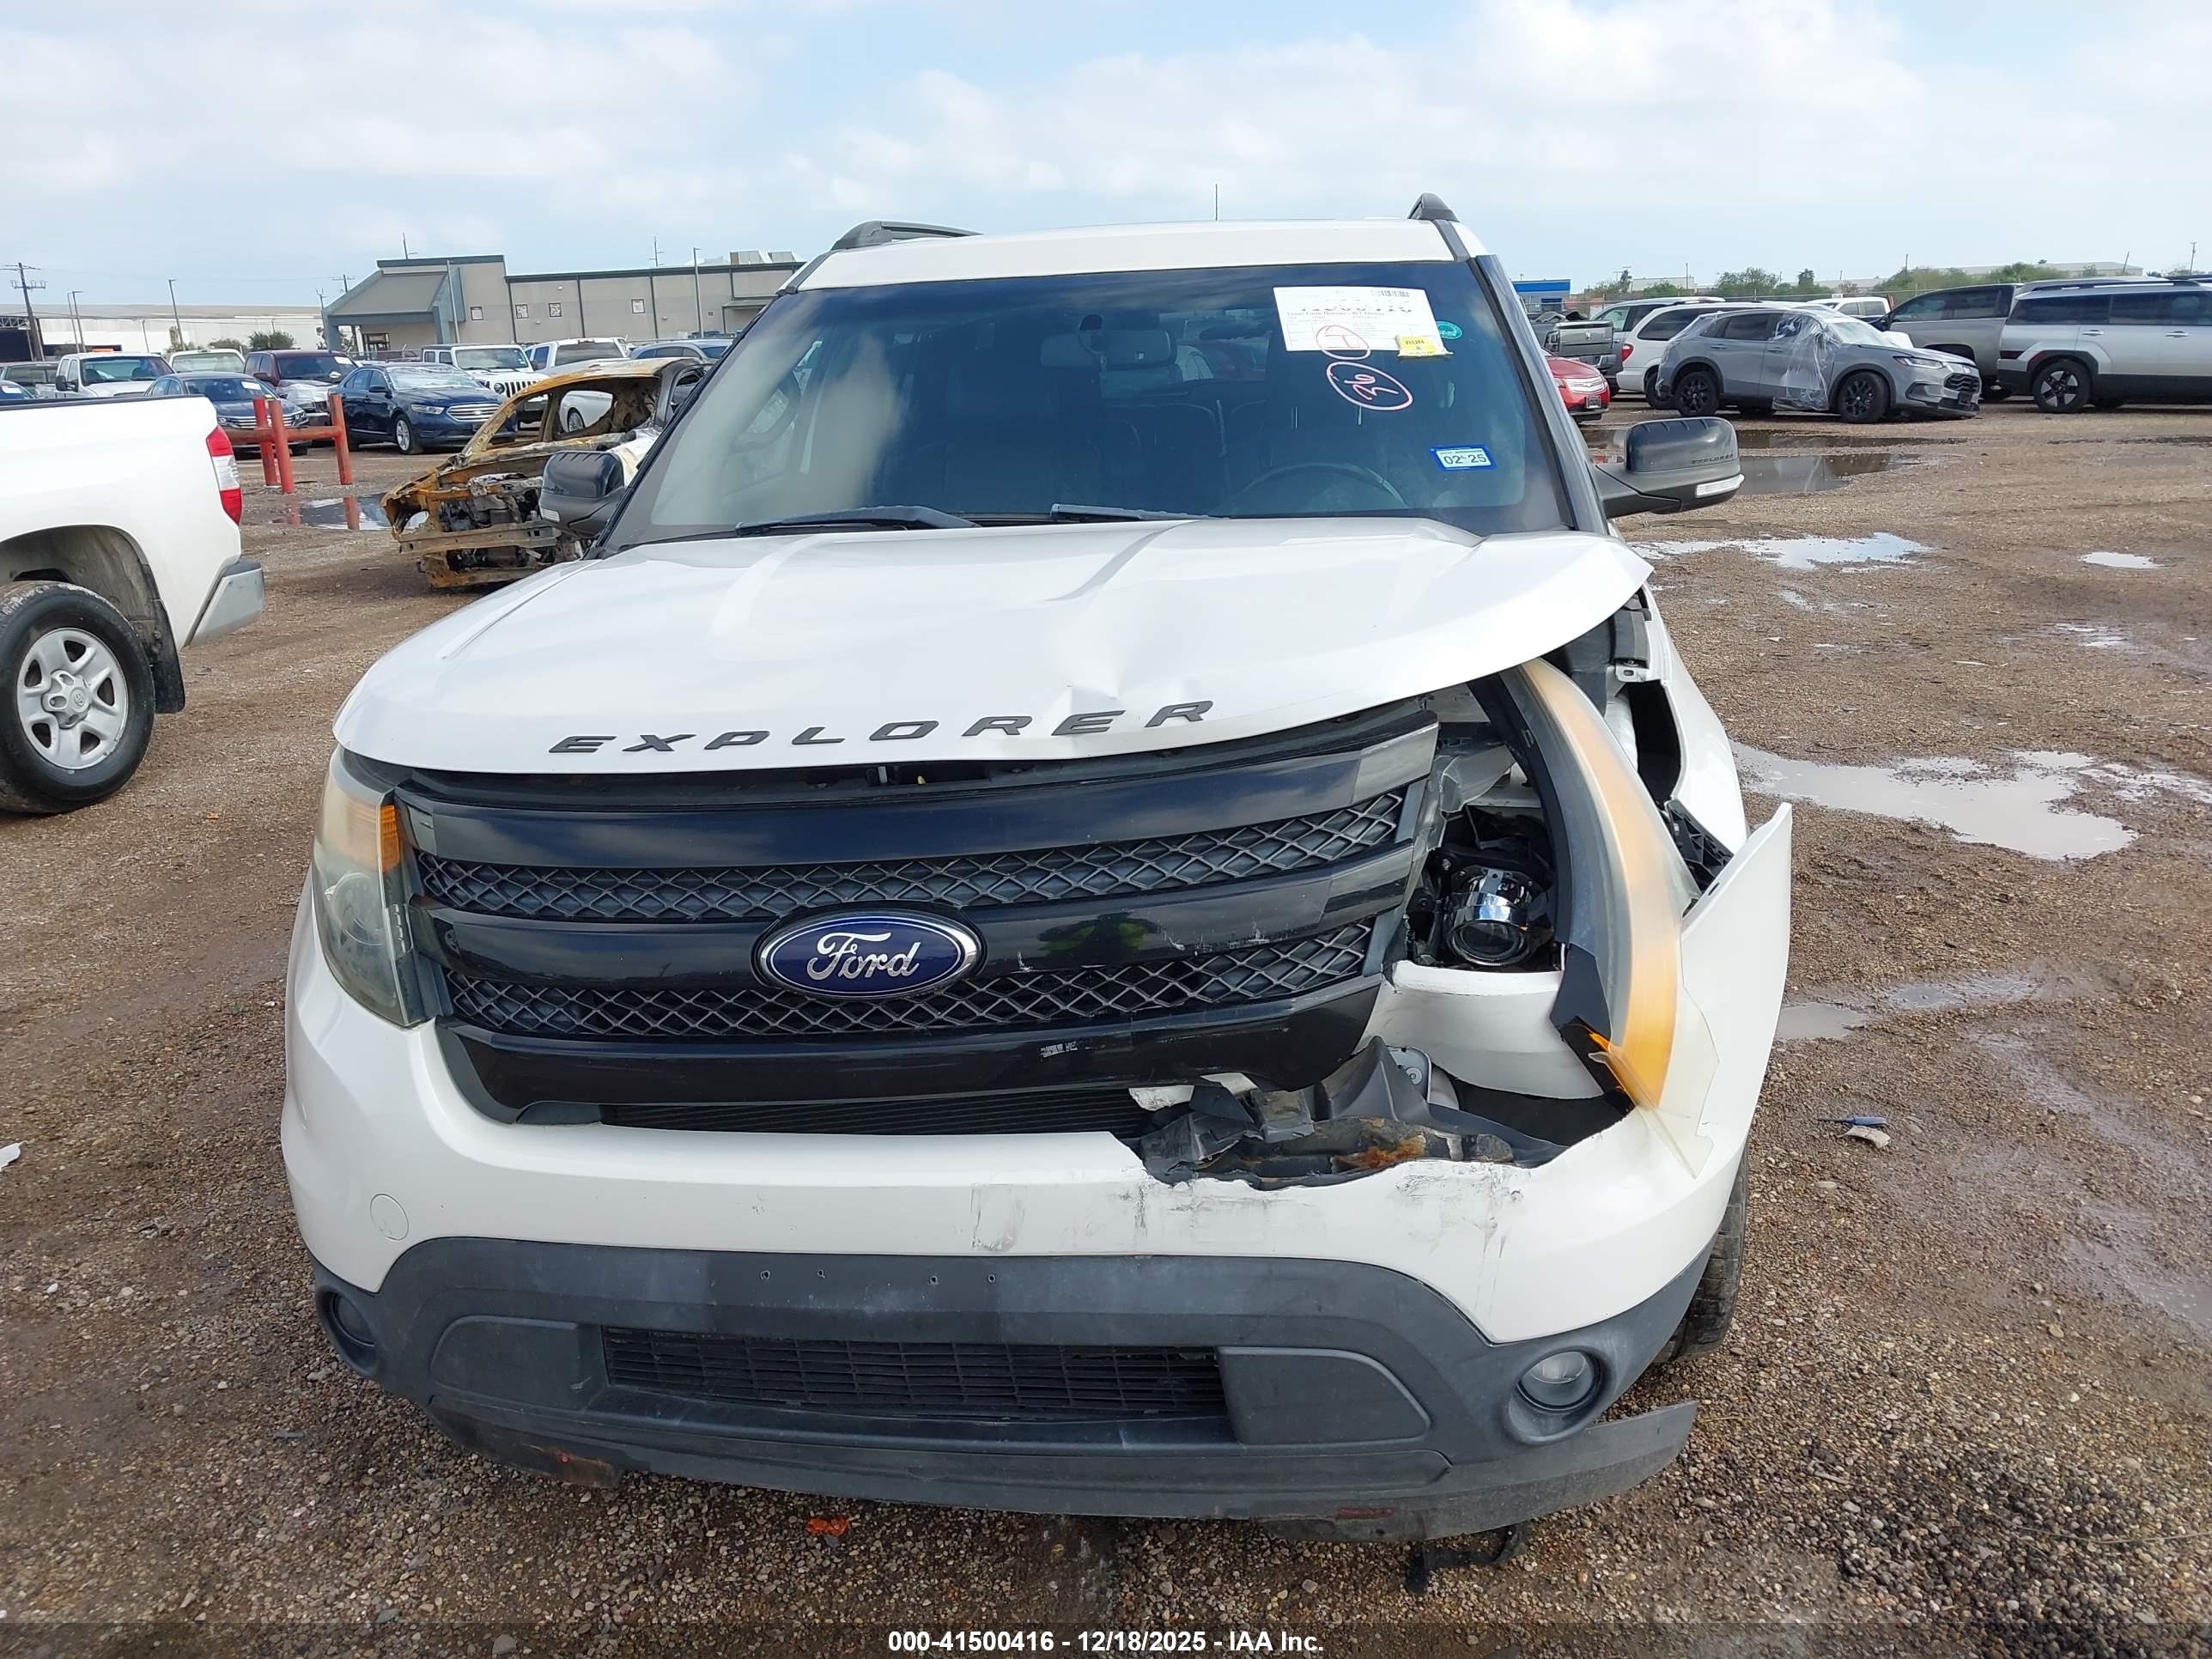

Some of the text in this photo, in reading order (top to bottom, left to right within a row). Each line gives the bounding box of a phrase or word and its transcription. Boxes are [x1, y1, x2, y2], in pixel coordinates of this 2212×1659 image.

[1443, 453, 1487, 465] 02 25
[547, 699, 1214, 754] EXPLORER
[806, 932, 921, 981] Ford
